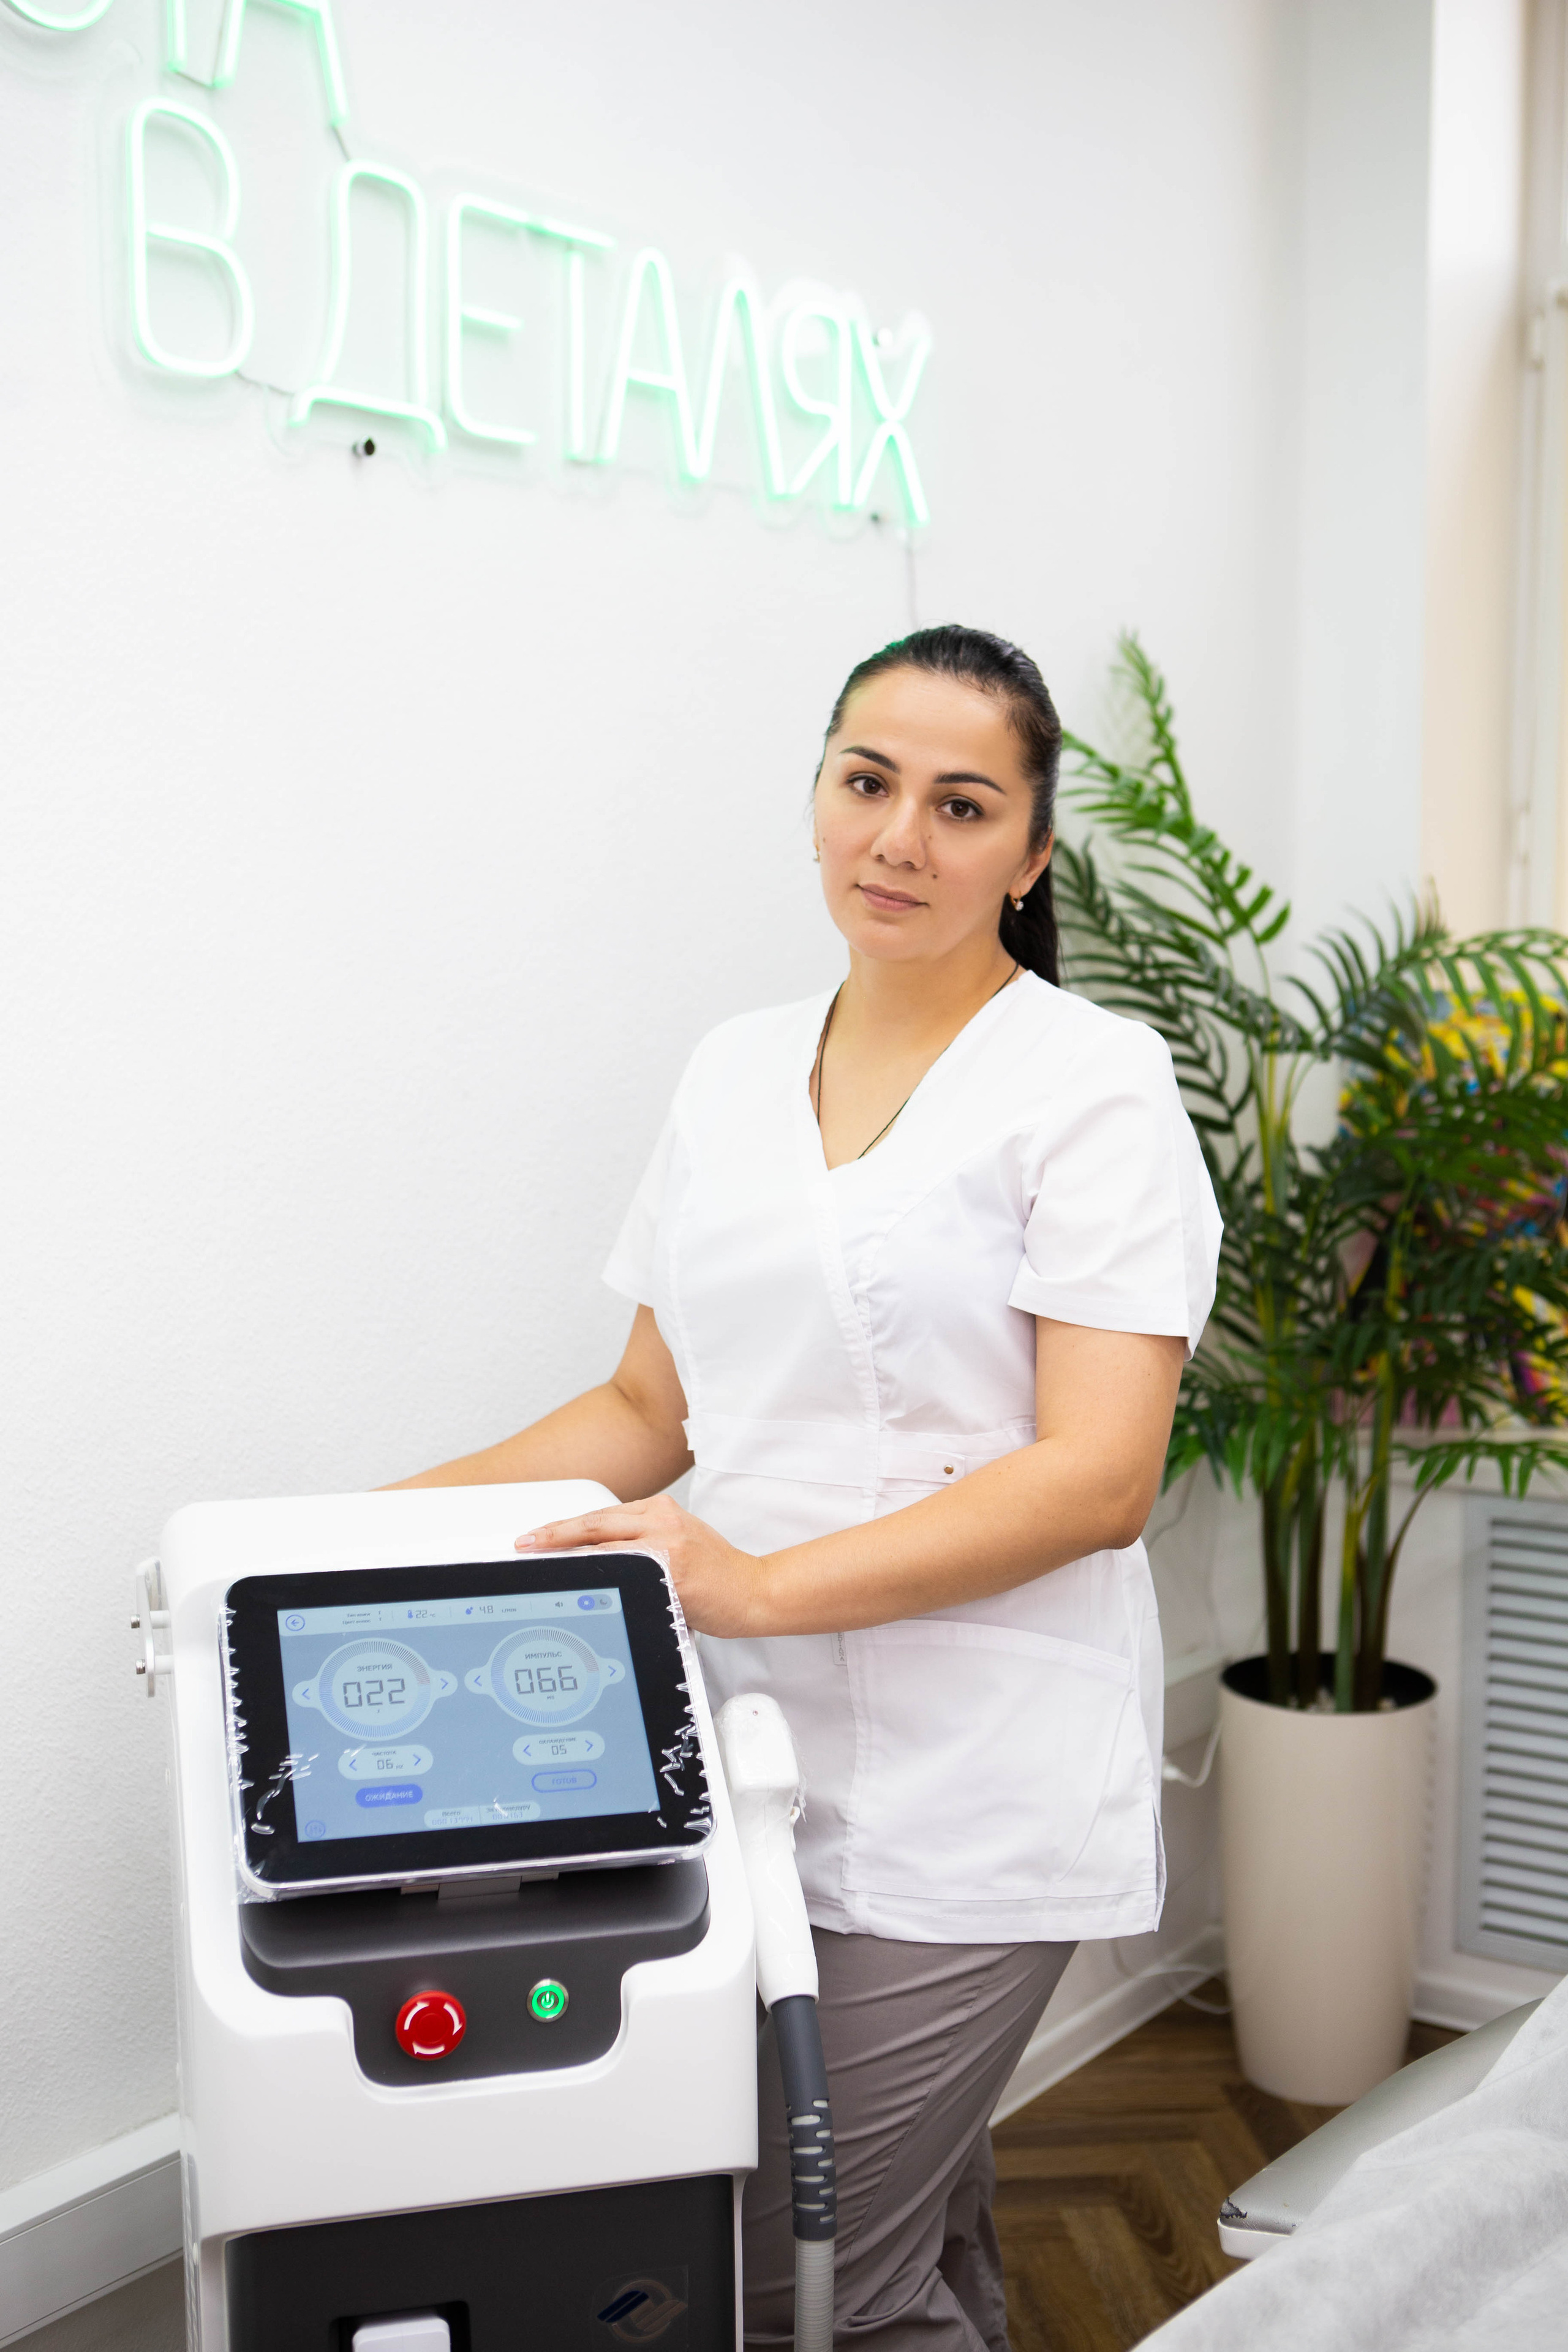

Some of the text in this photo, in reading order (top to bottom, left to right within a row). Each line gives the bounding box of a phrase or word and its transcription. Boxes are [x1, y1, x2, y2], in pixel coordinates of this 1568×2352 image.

[126, 96, 931, 528] В ДЕТАЛЯХ
[415, 1609, 428, 1619] 22
[479, 1605, 494, 1615] 48
[525, 1651, 563, 1660] ИМПУЛЬС
[356, 1664, 393, 1672] ЭНЕРГИЯ
[514, 1665, 578, 1695] 066
[342, 1678, 405, 1708] 022
[551, 1744, 567, 1755] 05
[377, 1758, 393, 1770] 06
[365, 1790, 413, 1801] ОЖИДАНИЕ
